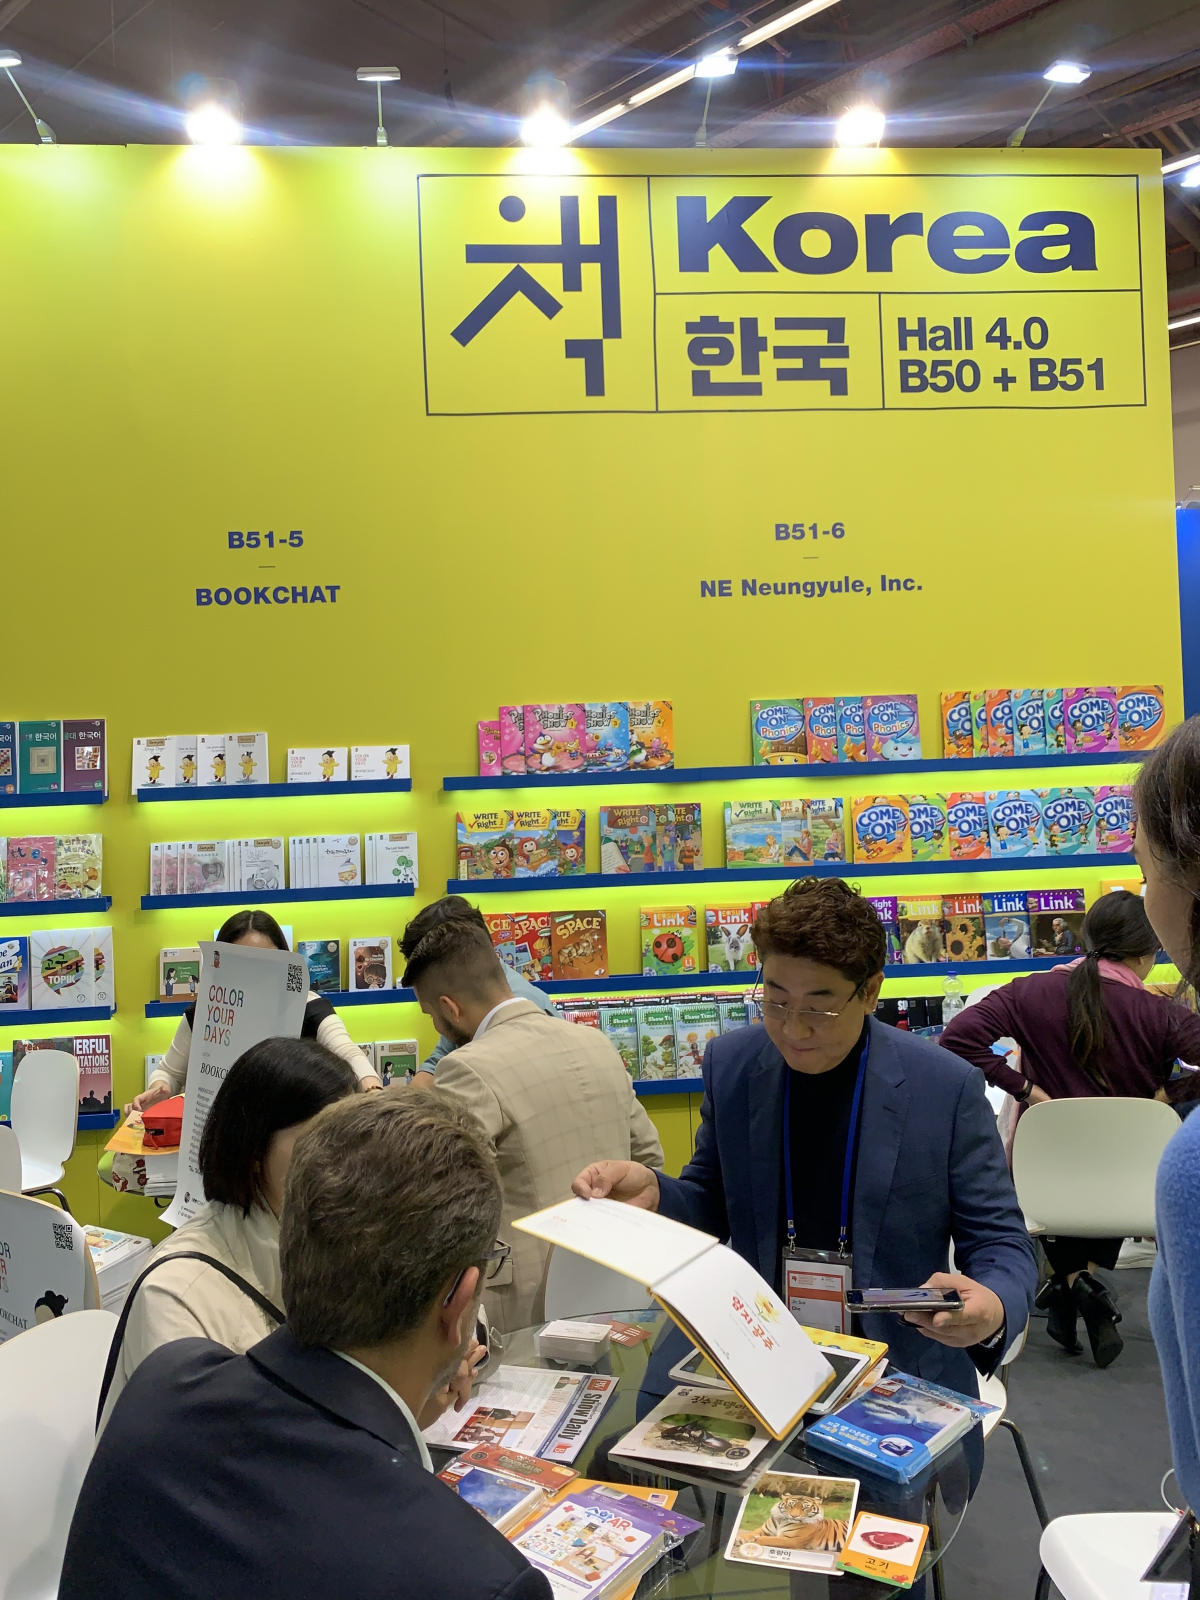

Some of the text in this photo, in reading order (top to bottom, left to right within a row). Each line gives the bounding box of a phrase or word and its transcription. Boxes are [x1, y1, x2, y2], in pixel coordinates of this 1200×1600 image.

[676, 195, 1098, 274] Korea
[898, 317, 1048, 352] Hall 4.0
[685, 315, 850, 396] 한국
[900, 358, 1105, 393] B50 + B51
[774, 523, 846, 540] B51-6
[227, 531, 304, 549] B51-5
[700, 574, 923, 599] NE Neungyule, Inc.
[195, 585, 341, 607] BOOKCHAT
[760, 707, 789, 720] COME
[871, 703, 900, 716] COME
[1070, 699, 1109, 719] COME
[1117, 696, 1155, 715] COME
[768, 716, 787, 727] ON
[880, 711, 898, 722] ON
[1083, 712, 1107, 729] ON
[1128, 708, 1153, 724] ON
[761, 725, 799, 737] Phonics
[873, 720, 910, 733] Phonics
[35, 732, 57, 741] 한국어
[79, 731, 101, 740] 한국어
[516, 811, 541, 819] WRITE
[613, 808, 640, 816] WRITE
[744, 808, 762, 818] Right
[948, 805, 987, 824] COME
[993, 803, 1033, 822] COME
[1043, 800, 1086, 820] COME
[1095, 798, 1132, 818] COME
[476, 819, 497, 829] Right
[519, 816, 548, 827] Right 2
[571, 816, 577, 824] 3
[617, 816, 639, 826] Right
[859, 807, 900, 826] COME
[1005, 815, 1032, 831] ON
[1058, 812, 1084, 829] ON
[1106, 811, 1131, 827] ON
[870, 820, 897, 837] ON
[909, 819, 935, 836] ON
[958, 818, 984, 834] ON
[910, 903, 940, 916] Link
[955, 900, 983, 914] Link
[994, 898, 1025, 912] Link
[1040, 896, 1074, 910] Link
[653, 913, 685, 926] Link
[718, 909, 749, 924] Link
[556, 917, 602, 939] SPACE
[48, 975, 76, 985] TOPIK
[208, 985, 244, 1008] COLOR
[207, 1004, 235, 1026] YOUR
[203, 1024, 231, 1047] DAYS
[92, 1066, 109, 1074] SUCCESS
[200, 1062, 229, 1080] BOOKC
[574, 1393, 603, 1418] Show
[557, 1417, 588, 1441] Daily
